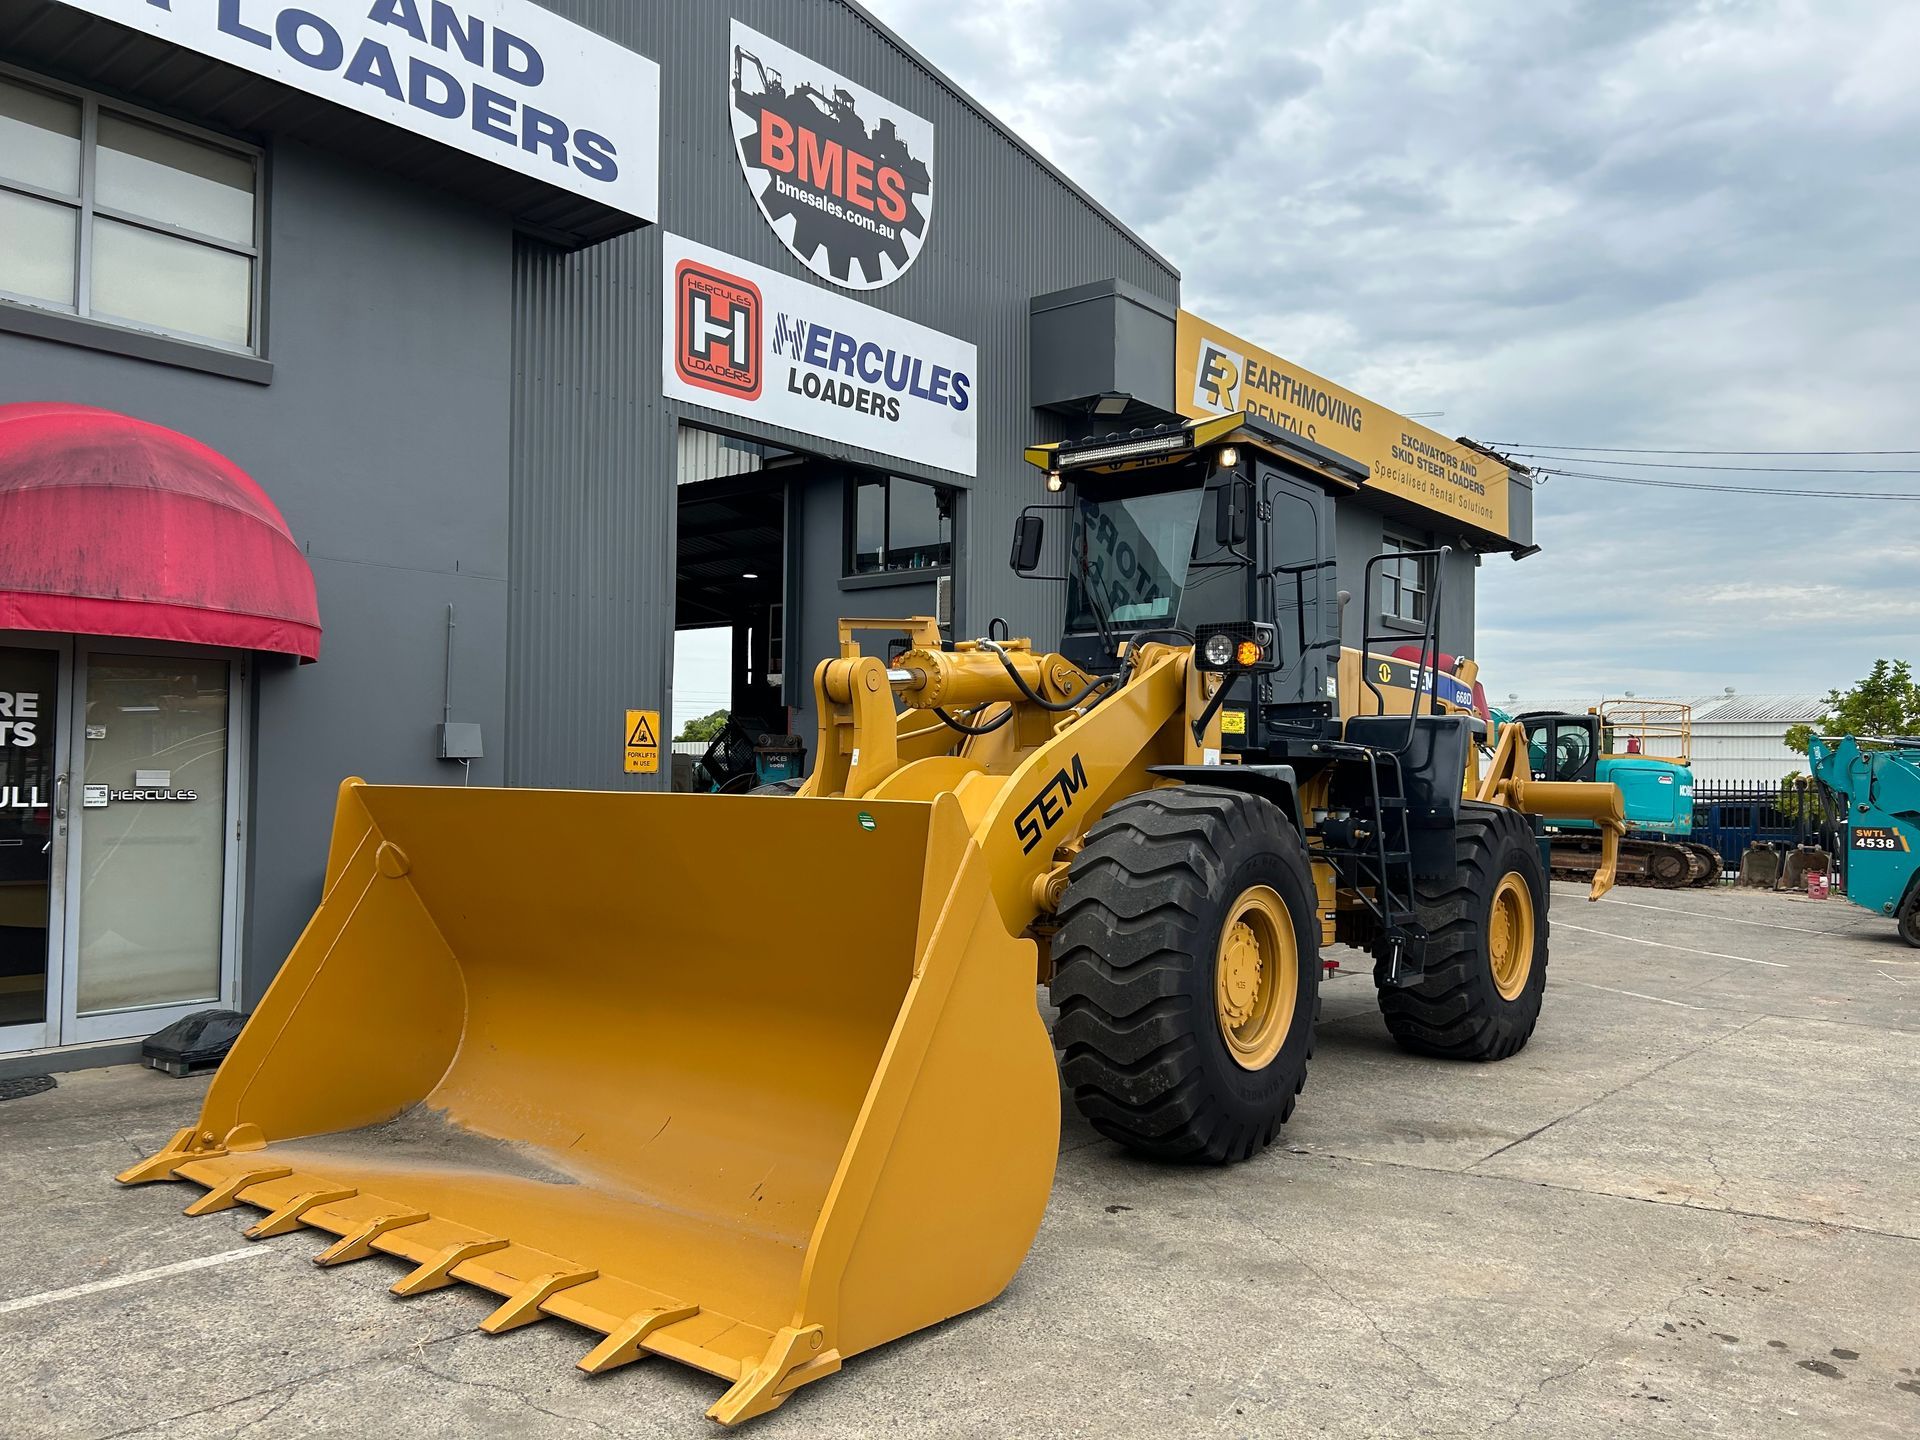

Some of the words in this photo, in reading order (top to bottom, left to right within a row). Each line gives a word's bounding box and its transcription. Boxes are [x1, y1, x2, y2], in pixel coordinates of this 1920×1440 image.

[367, 0, 545, 87] AND
[217, 0, 619, 183] LOADERS
[760, 107, 907, 223] BMES
[775, 175, 896, 241] bmesales.com.au
[687, 278, 752, 307] HERCULES
[687, 356, 752, 384] LOADERS
[771, 312, 971, 411] HERCULES
[787, 367, 901, 423] LOADERS
[1244, 358, 1363, 433] EARTHMOVING
[1391, 444, 1414, 465] SKID
[1416, 455, 1445, 479] STEER
[1447, 469, 1486, 497] LOADERS
[1400, 432, 1459, 470] EXCAVATORS
[1460, 460, 1477, 478] AND
[1374, 460, 1427, 493] Specialised
[1429, 482, 1456, 505] Rental
[1458, 495, 1494, 520] Solutions
[627, 751, 657, 759] FORKLIFTS
[109, 790, 198, 801] HERCULES
[1013, 752, 1089, 856] SEM
[1856, 829, 1887, 838] SWTL
[1856, 838, 1895, 849] 4538
